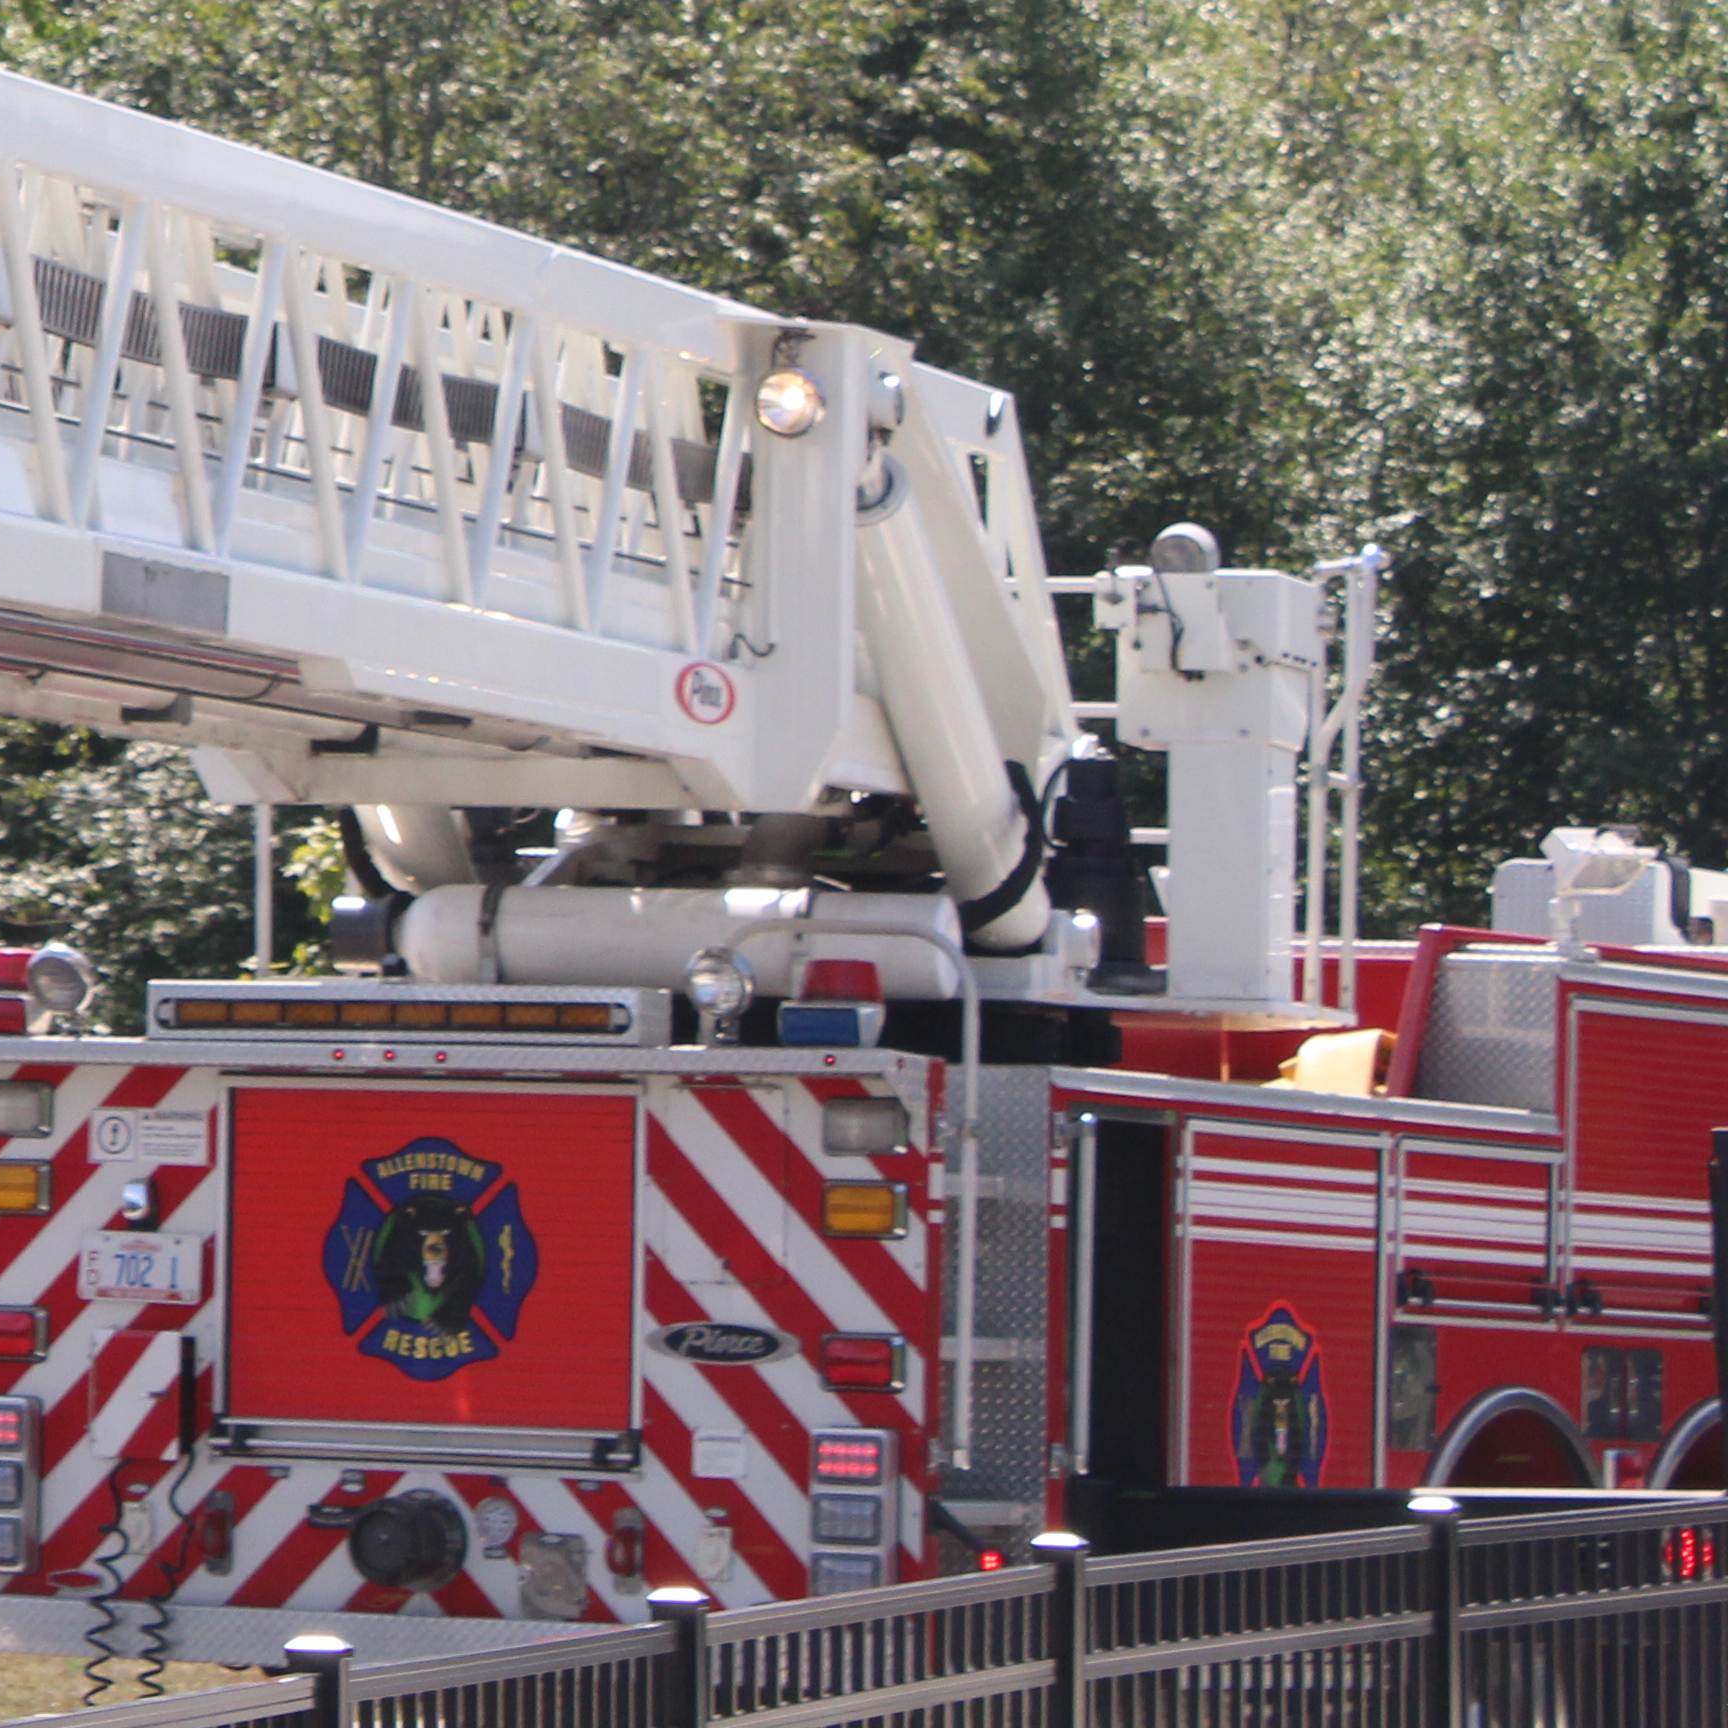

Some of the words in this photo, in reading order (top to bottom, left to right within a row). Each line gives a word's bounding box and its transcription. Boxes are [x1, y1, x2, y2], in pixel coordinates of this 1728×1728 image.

[377, 1153, 486, 1182] ALLENSTOWN
[410, 1173, 453, 1191] FIRE
[114, 1253, 154, 1287] 702
[383, 1329, 475, 1360] RESCUE
[678, 1326, 766, 1356] Pierce
